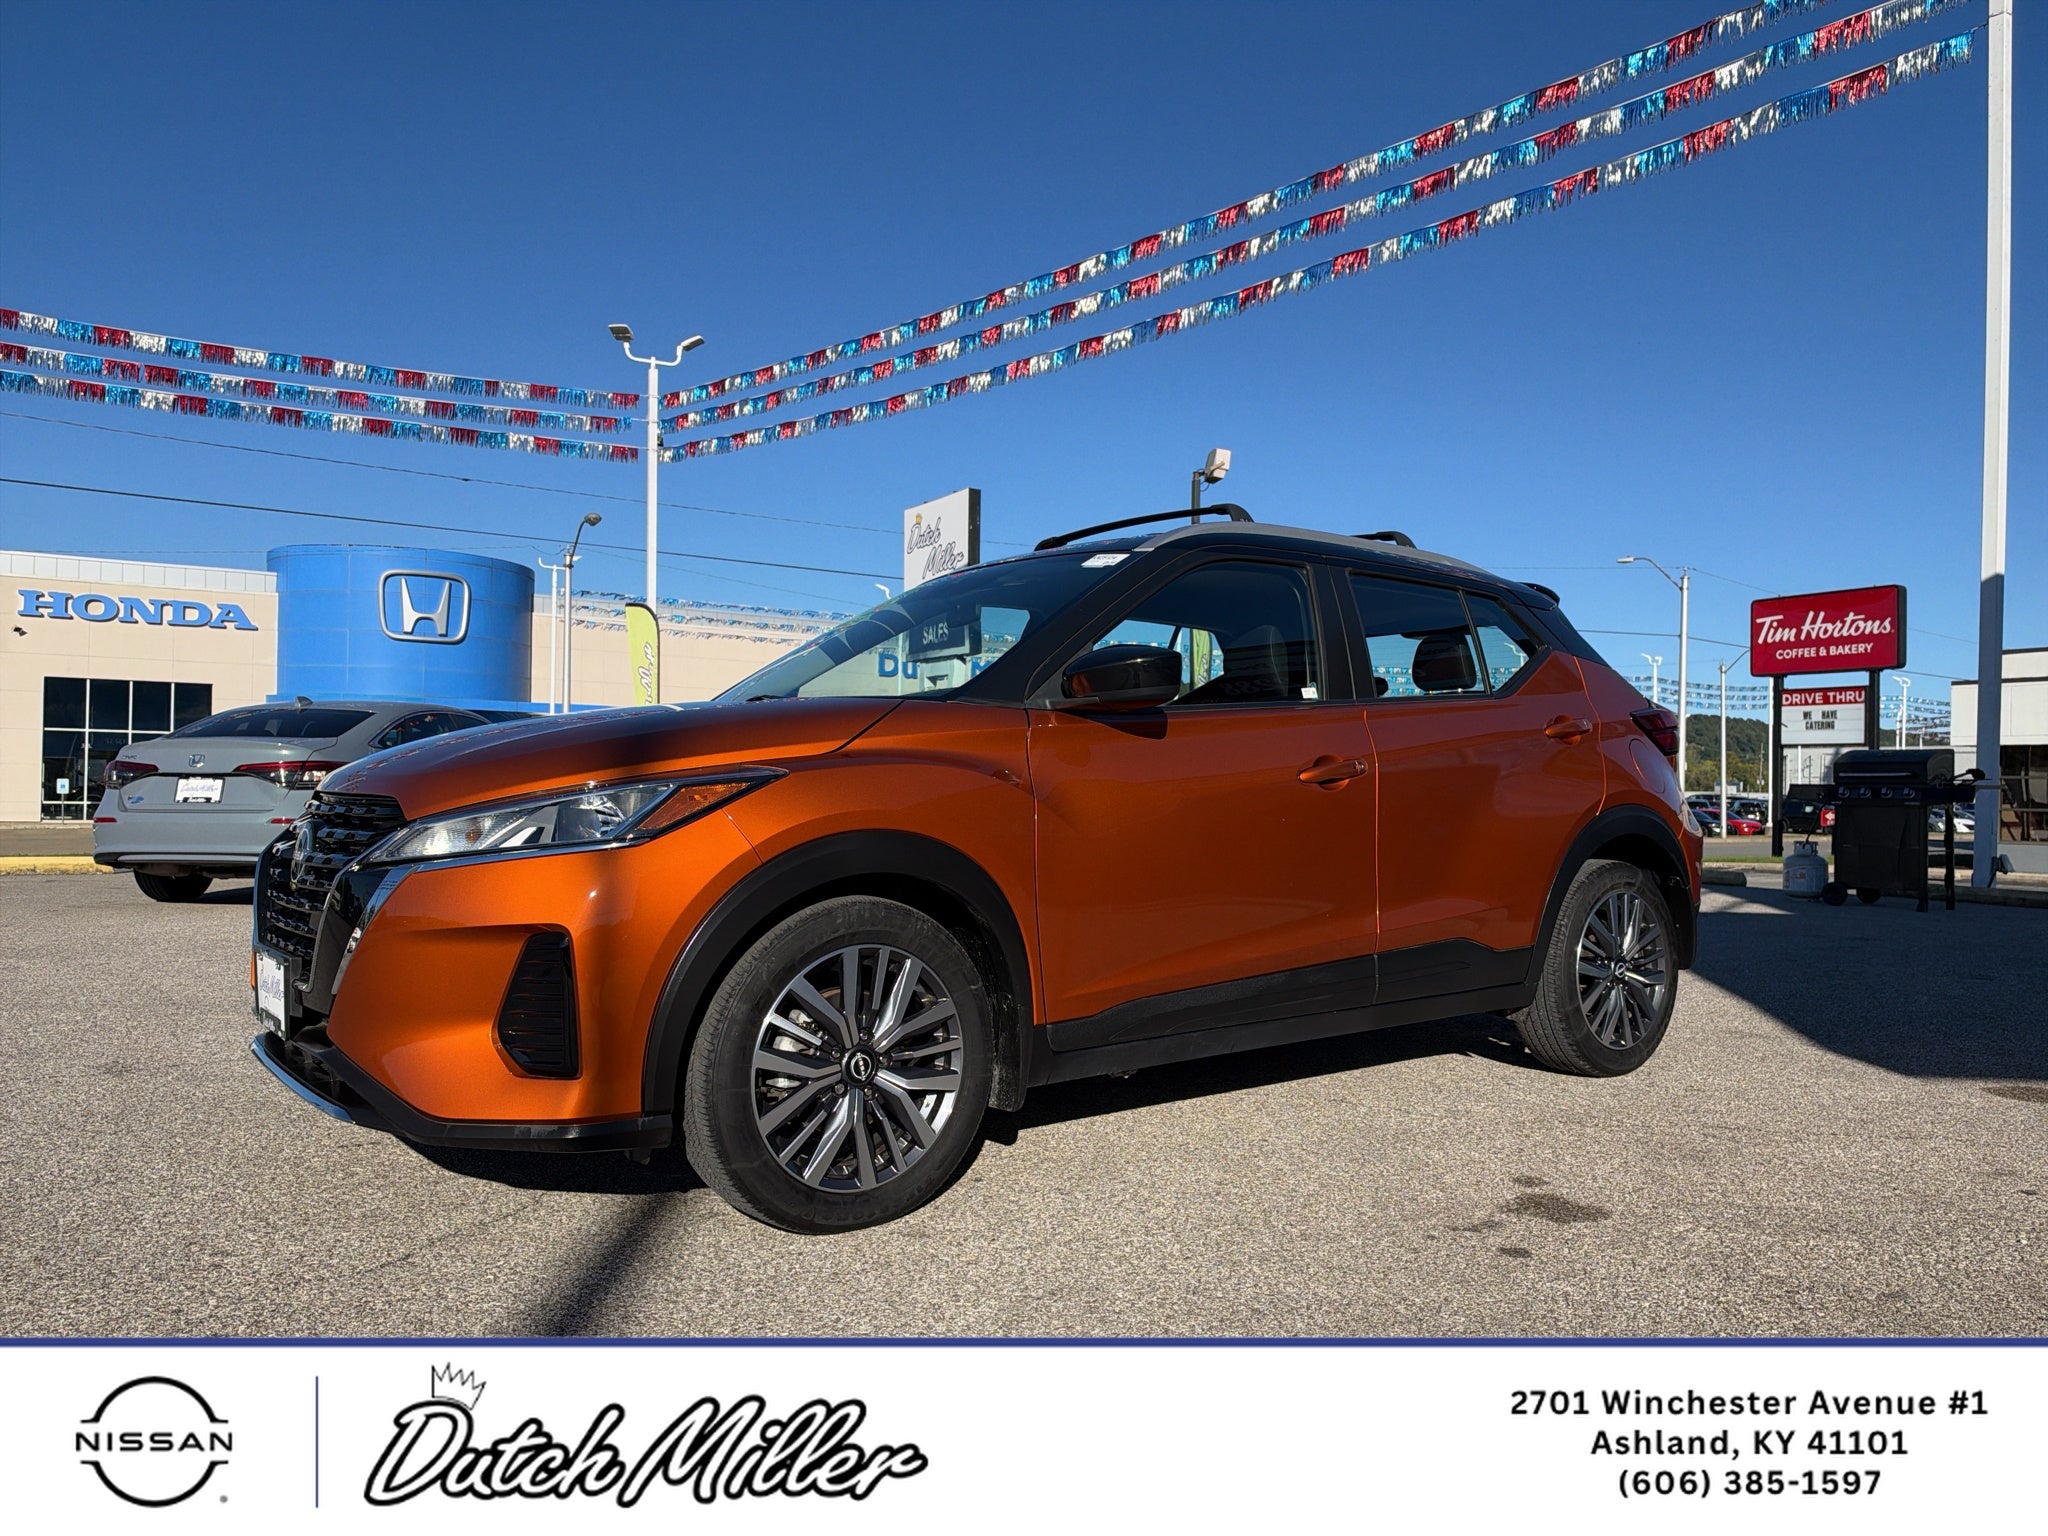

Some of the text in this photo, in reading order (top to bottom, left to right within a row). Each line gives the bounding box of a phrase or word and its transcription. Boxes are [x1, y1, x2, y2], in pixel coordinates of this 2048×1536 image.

[907, 516, 942, 555] Dutch
[922, 541, 965, 580] Miller
[17, 589, 259, 631] HONDA
[922, 621, 950, 646] SALES
[1755, 610, 1892, 645] Tim Hortons
[1776, 643, 1873, 659] COFFEE & BAKERY
[1782, 690, 1865, 705] DRIVE THRU
[1803, 710, 1837, 720] WE HAVE
[1805, 721, 1835, 730] CATERING
